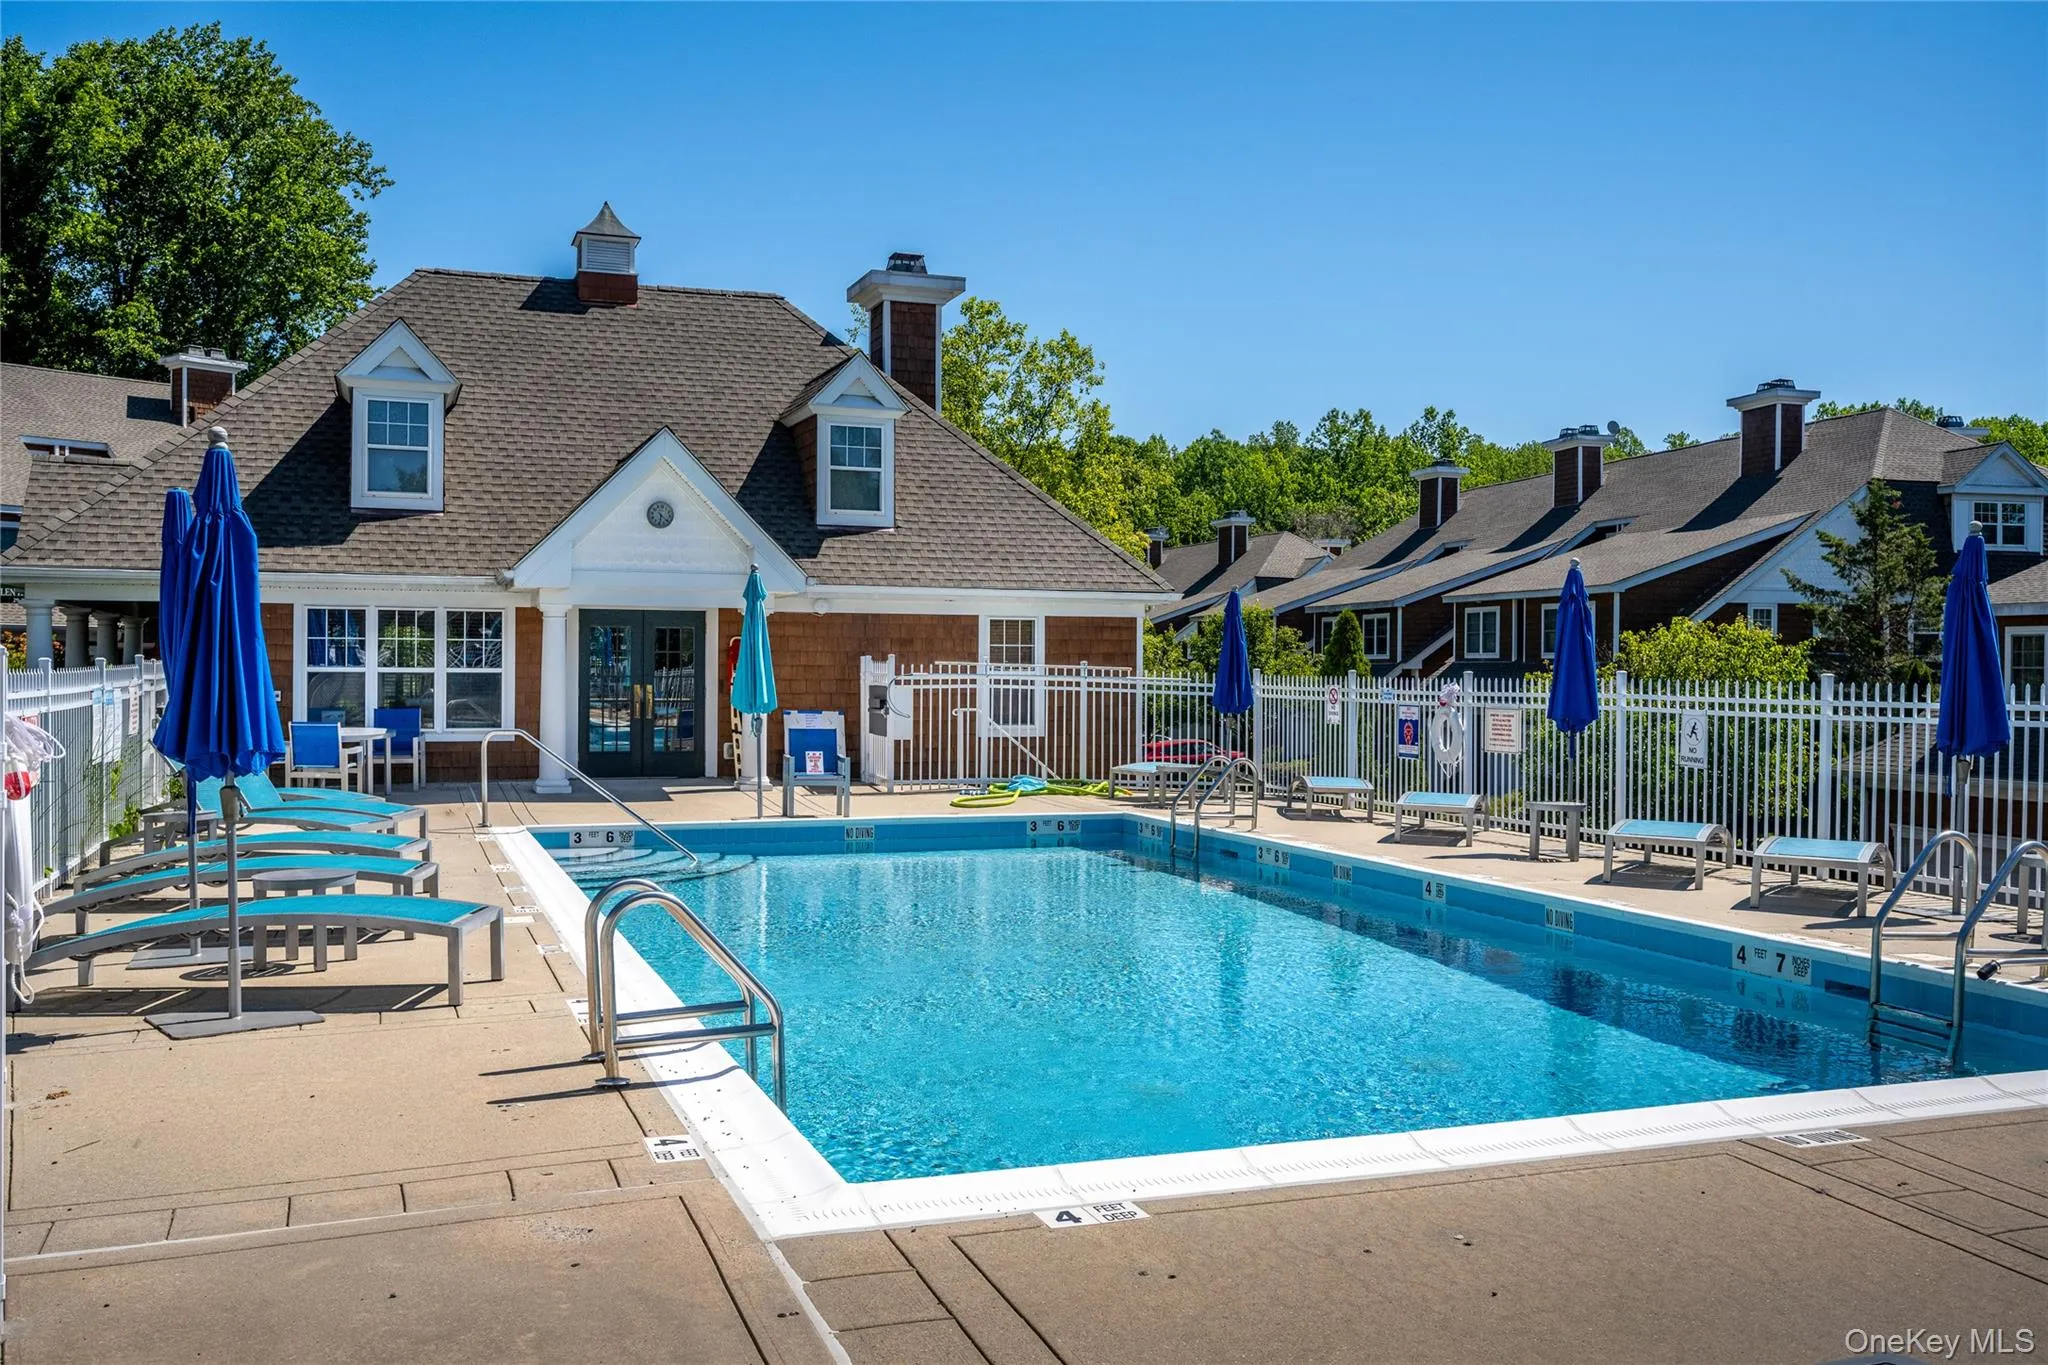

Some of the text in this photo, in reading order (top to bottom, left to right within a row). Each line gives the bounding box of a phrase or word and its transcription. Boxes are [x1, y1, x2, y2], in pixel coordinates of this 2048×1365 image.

[1681, 755, 1704, 765] RUNNING
[846, 827, 874, 839] NO DIVING
[1030, 820, 1037, 832] 3
[1057, 820, 1065, 832] 6
[574, 832, 582, 844] 3
[606, 831, 615, 843] 6
[1258, 846, 1263, 859] 3
[1274, 849, 1280, 863] 6
[1425, 880, 1431, 897] 4
[1545, 908, 1573, 930] NO DIVING
[1736, 944, 1747, 965] 4
[1753, 947, 1768, 960] FEET
[1775, 952, 1786, 973] 7
[1055, 1202, 1127, 1224] 4 FEET
[1102, 1211, 1138, 1222] DEEP
